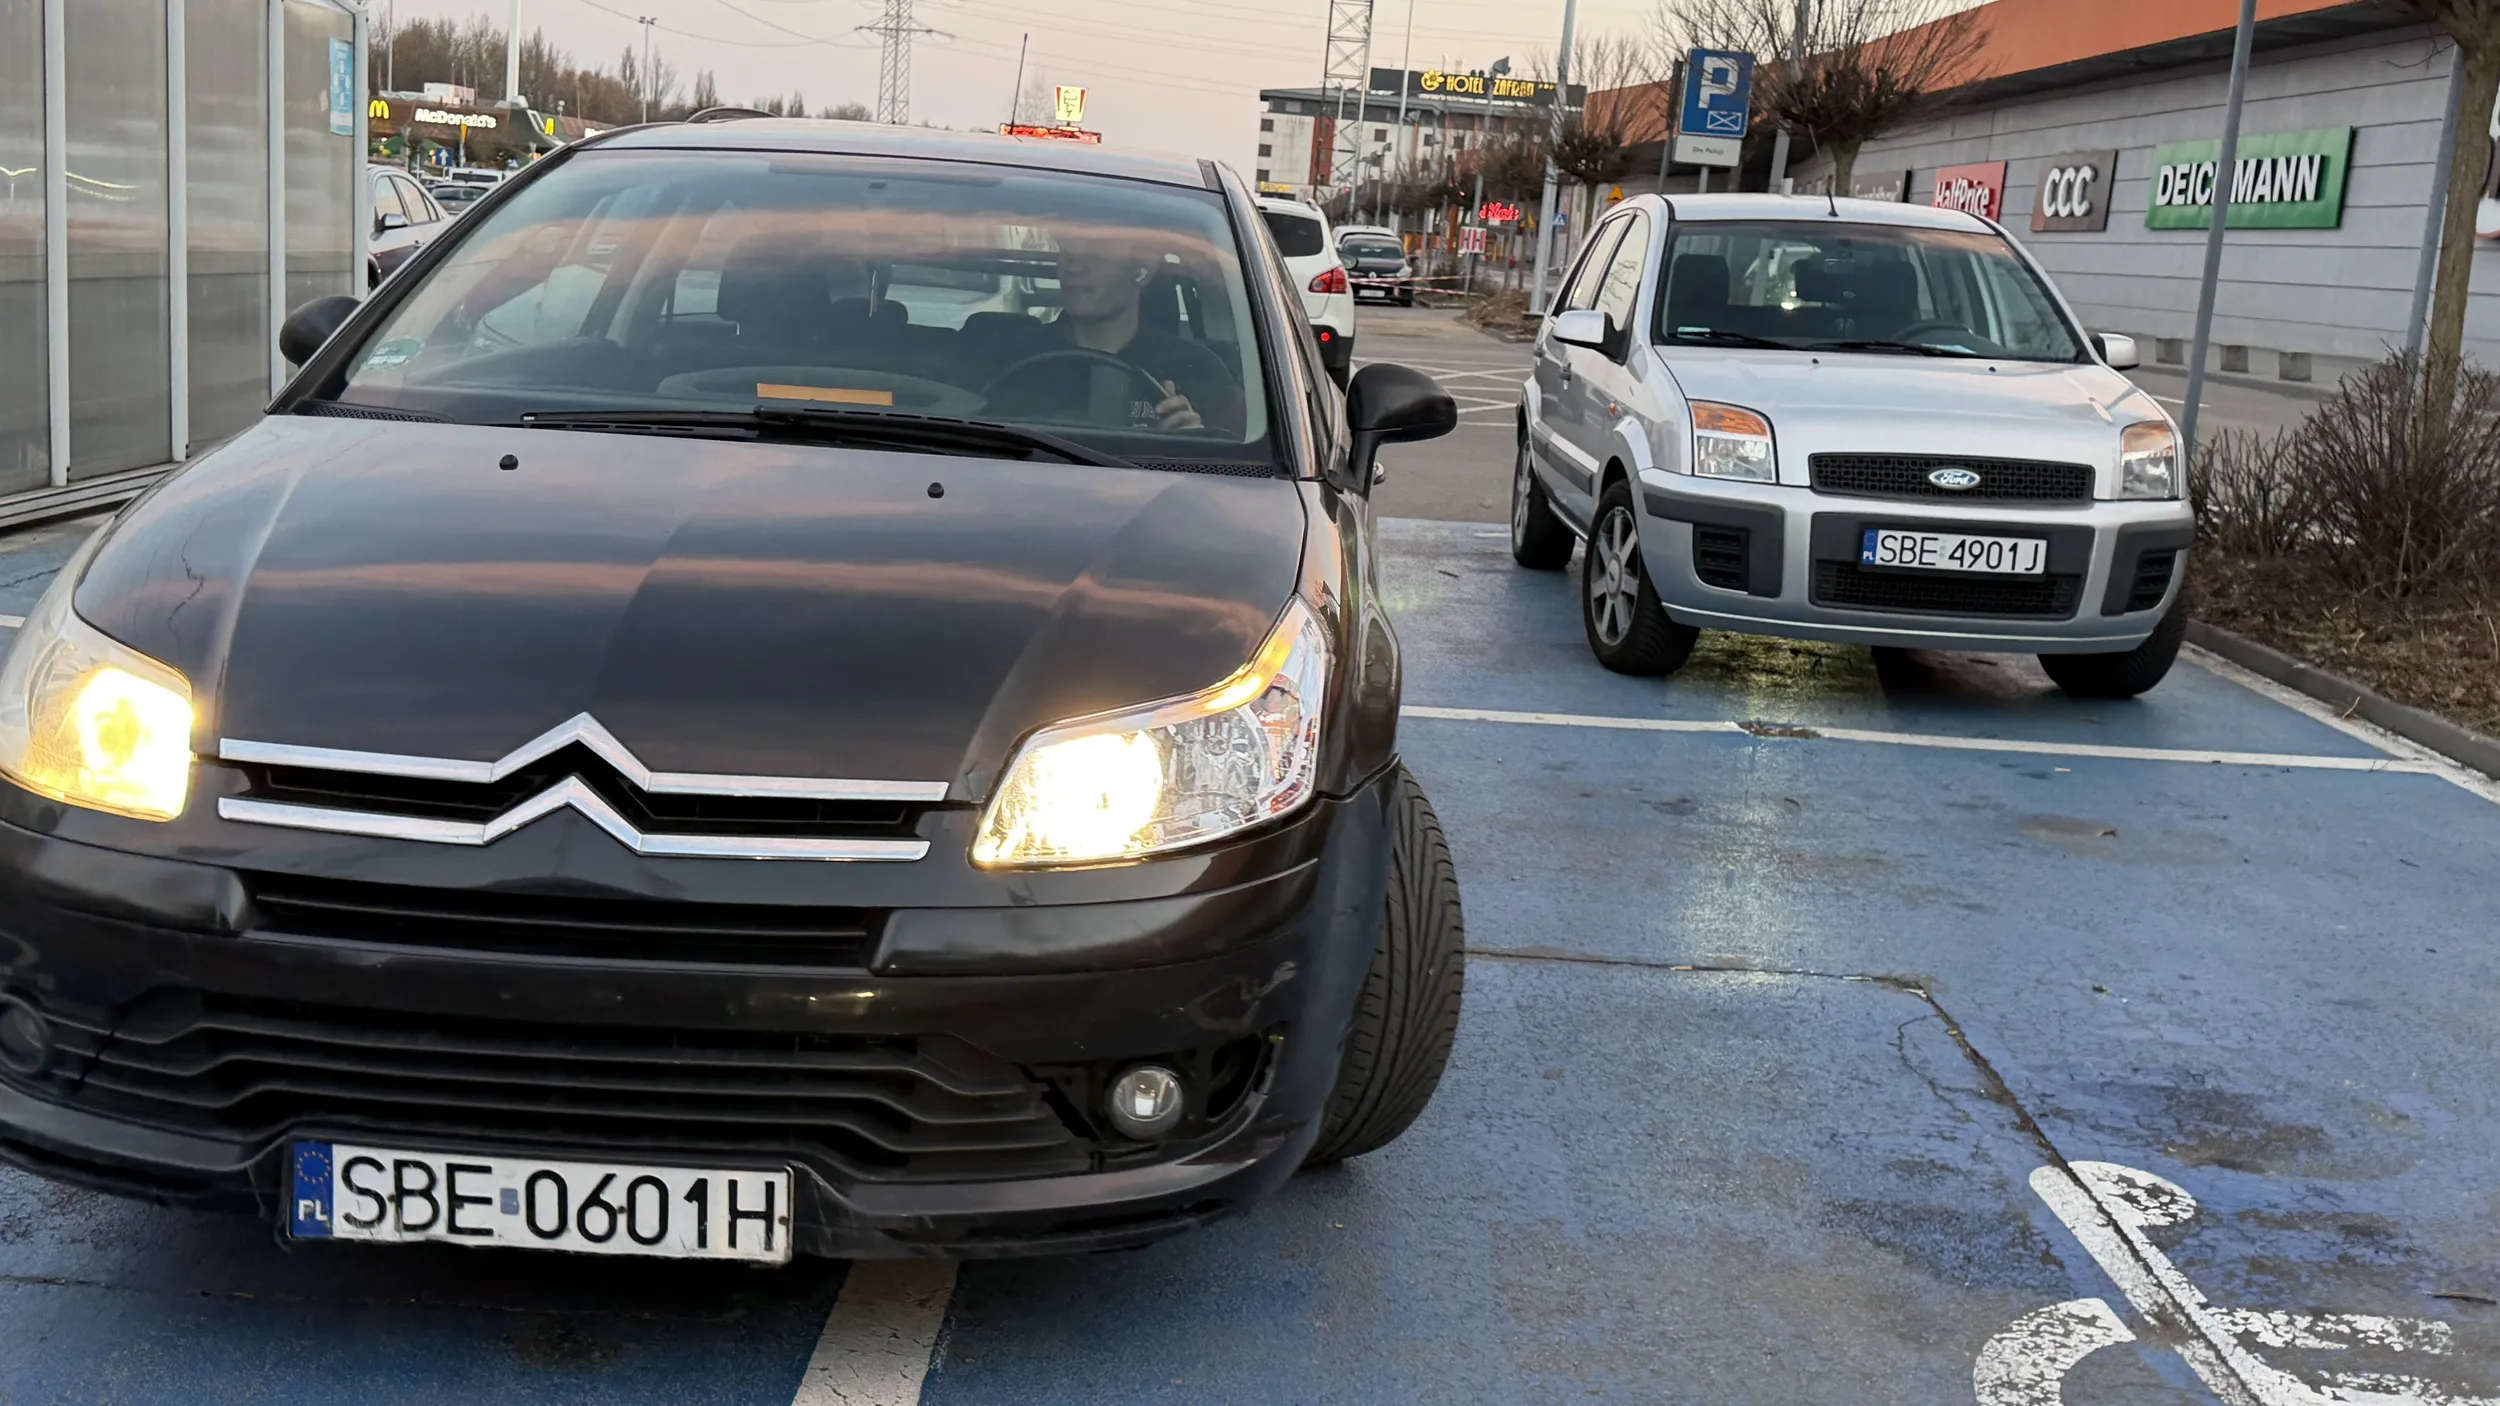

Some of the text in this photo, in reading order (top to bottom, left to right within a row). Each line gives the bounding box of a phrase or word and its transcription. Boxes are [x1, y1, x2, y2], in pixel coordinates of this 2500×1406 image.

[1446, 75, 1535, 97] HOTEL ZAFRAN
[1699, 56, 1739, 108] P
[415, 108, 497, 129] McDonald's
[1935, 178, 1991, 216] HalfPrice
[2042, 165, 2093, 218] CCC
[1940, 472, 1970, 485] Ford
[1862, 550, 1875, 561] PL
[1879, 534, 2040, 572] SBE 4901J
[298, 1200, 328, 1222] PL
[341, 1155, 777, 1252] SBE 0601H
